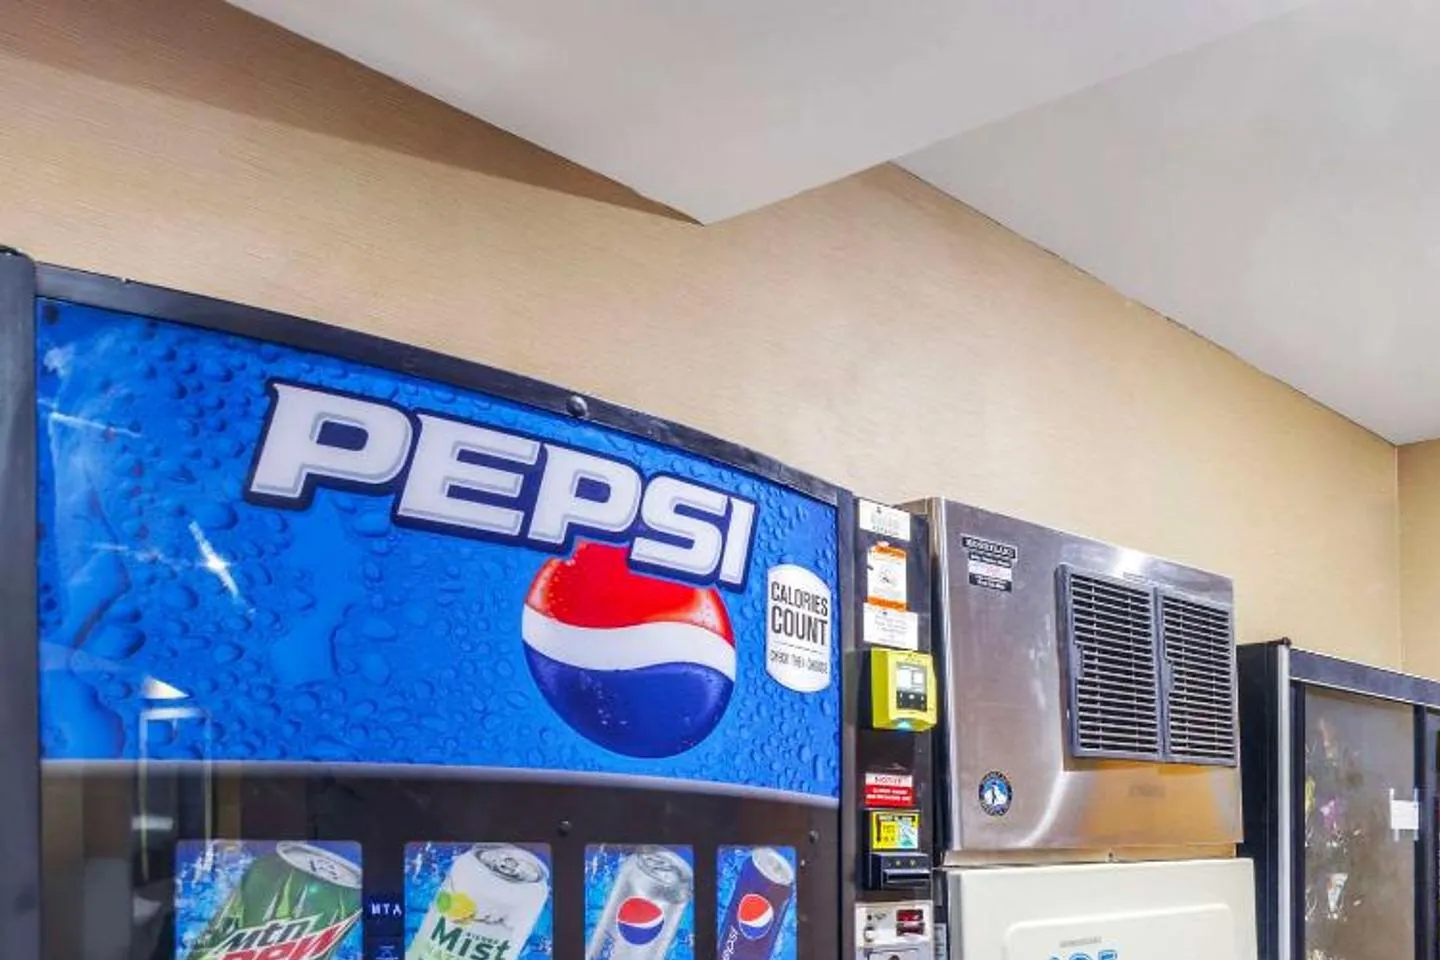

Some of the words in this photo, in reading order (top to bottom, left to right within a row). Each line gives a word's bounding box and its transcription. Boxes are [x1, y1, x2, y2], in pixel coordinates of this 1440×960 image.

[248, 382, 757, 585] PEPSI
[770, 581, 828, 617] CALORIES
[771, 605, 828, 646] COUNT
